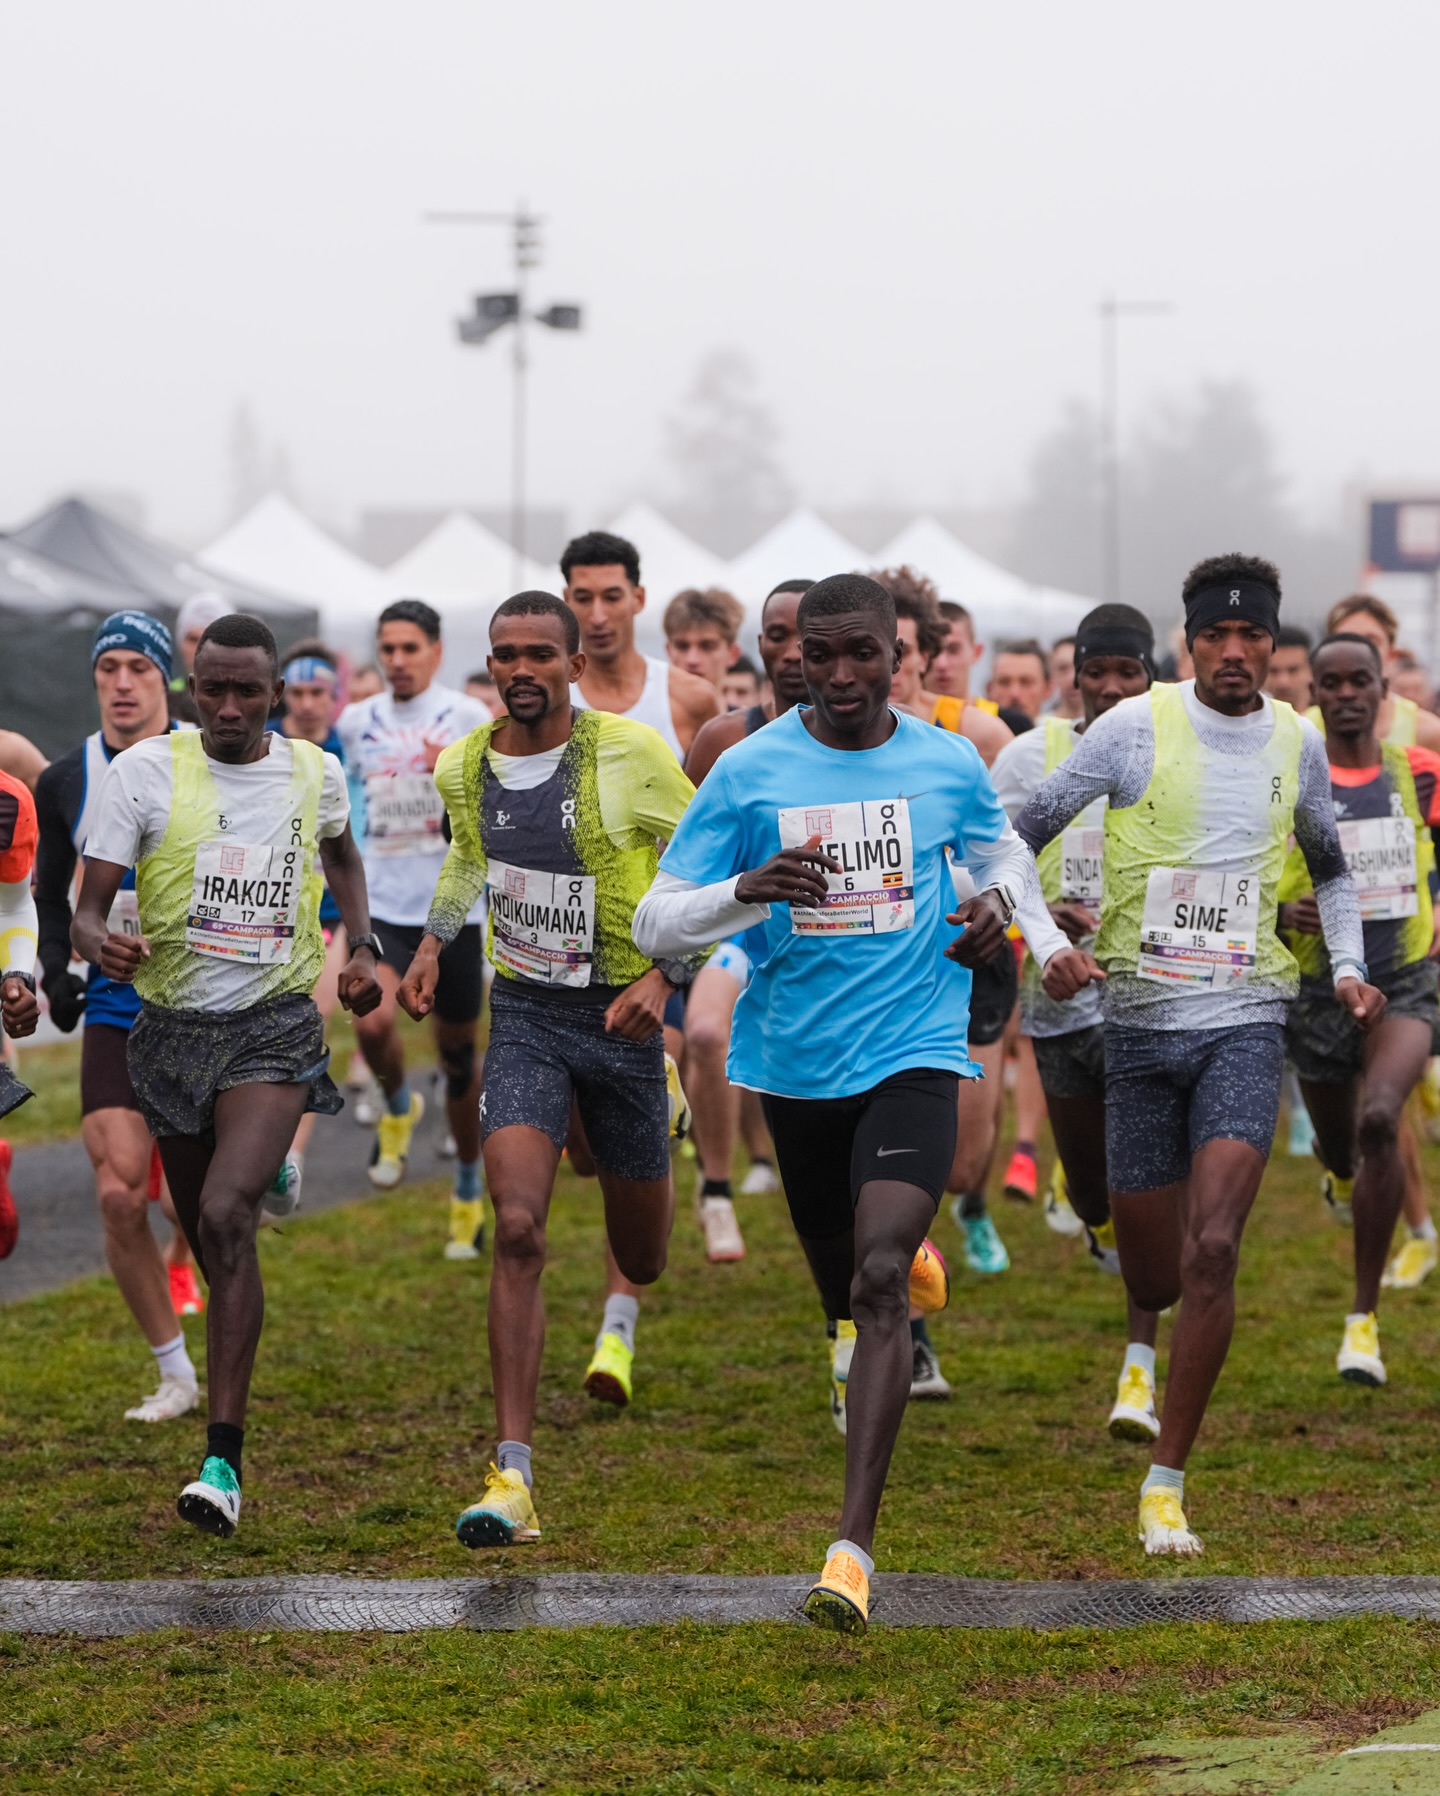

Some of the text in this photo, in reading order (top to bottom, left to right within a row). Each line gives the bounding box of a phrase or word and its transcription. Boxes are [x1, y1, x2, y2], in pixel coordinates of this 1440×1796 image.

[1065, 858, 1103, 882] SINDA
[203, 875, 292, 909] IRAKOZE
[844, 877, 855, 891] 6
[241, 910, 256, 924] 17
[492, 890, 587, 936] NDIKUMANA
[1174, 903, 1228, 933] SIME
[530, 932, 538, 944] 3
[1192, 935, 1206, 948] 15
